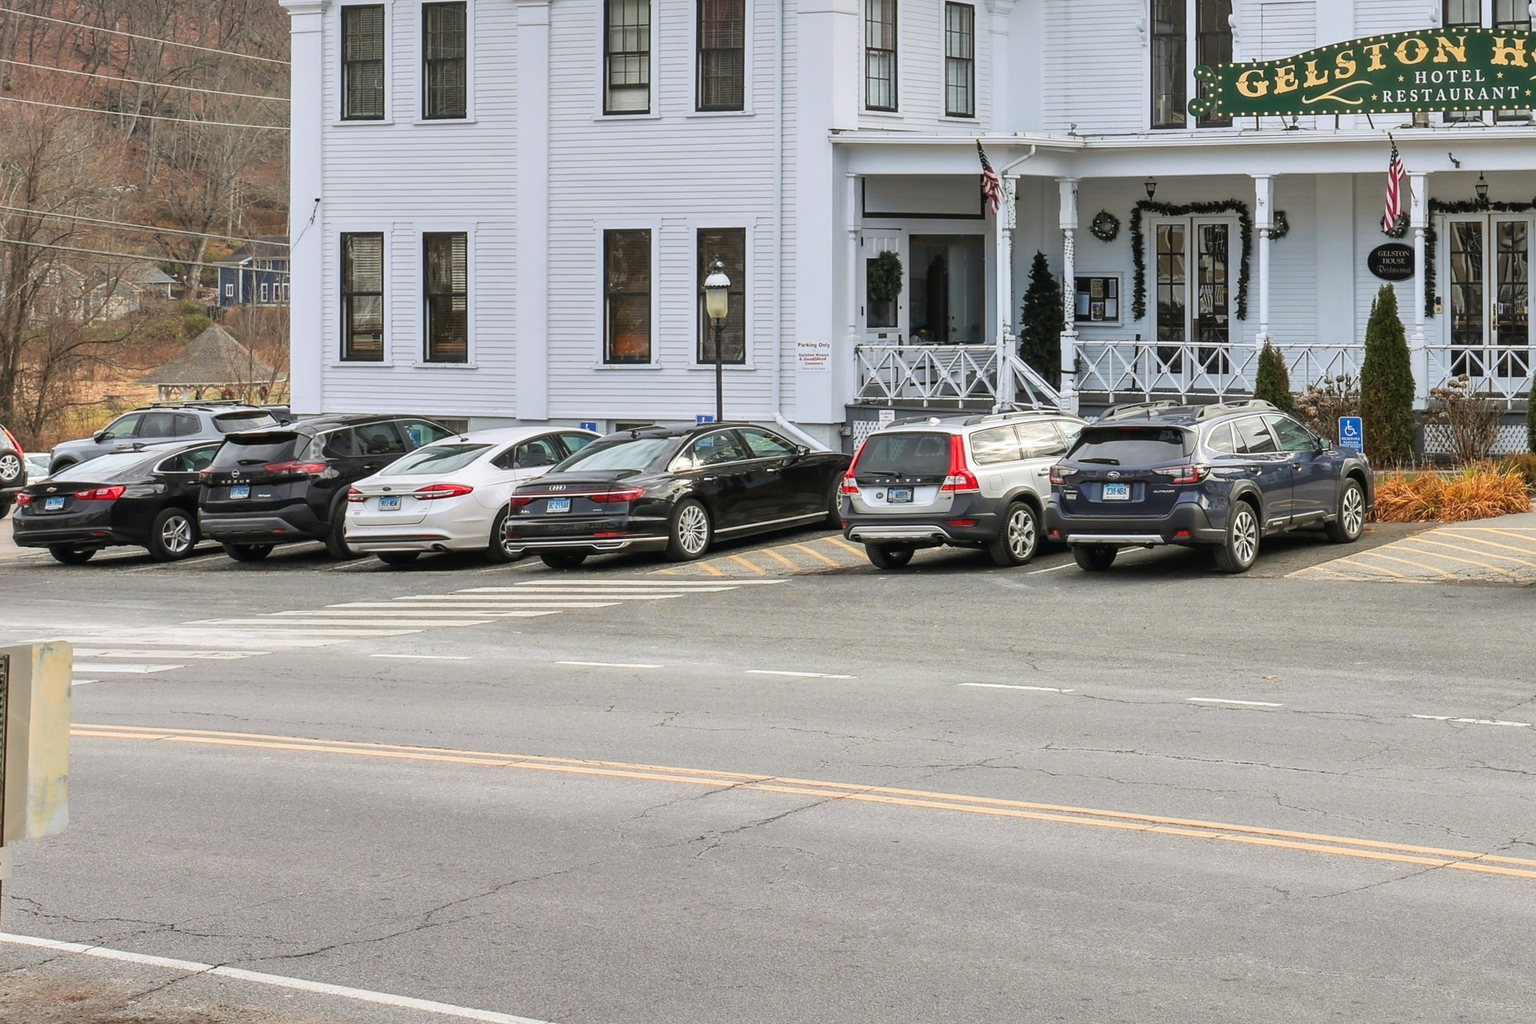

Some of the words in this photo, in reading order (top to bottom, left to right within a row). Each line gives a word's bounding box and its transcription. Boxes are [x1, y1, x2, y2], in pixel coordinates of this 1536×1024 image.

[1235, 35, 1468, 98] GELSTON
[1414, 69, 1486, 84] HOTEL
[1382, 85, 1520, 103] RESTAURANT
